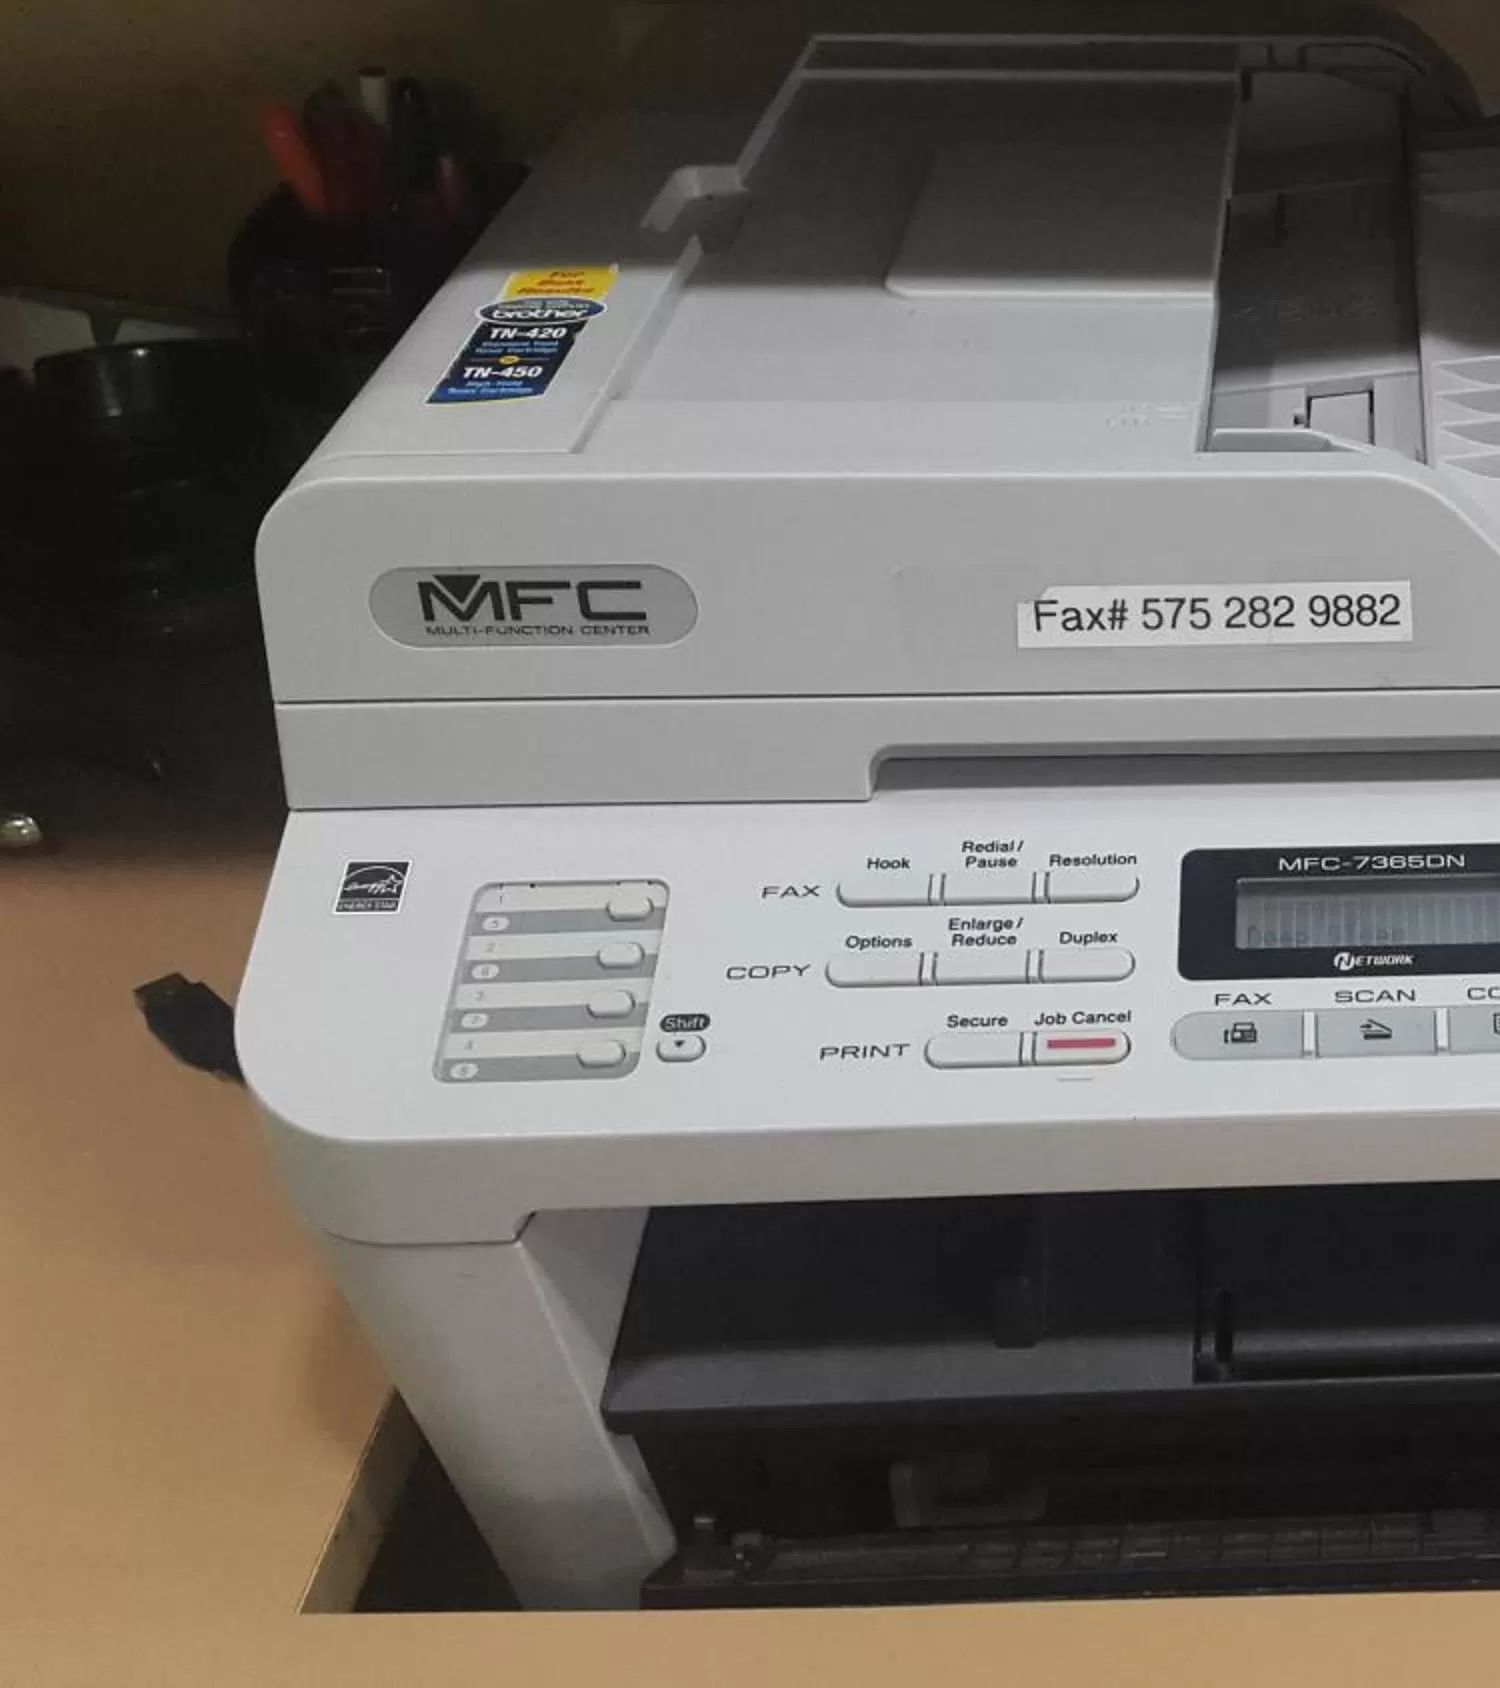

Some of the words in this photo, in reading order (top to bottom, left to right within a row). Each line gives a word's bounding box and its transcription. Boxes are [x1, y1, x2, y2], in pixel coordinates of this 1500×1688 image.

[492, 307, 587, 319] brother
[489, 327, 568, 339] TN-420
[462, 365, 544, 379] TN-450
[417, 575, 647, 621] MFC
[1032, 598, 1129, 632] Fax#
[1141, 596, 1212, 630] 575
[1223, 594, 1296, 629] 282
[1308, 593, 1402, 627] 9882
[425, 625, 573, 636] MULTI-FUNCTION
[580, 625, 650, 636] CENTER
[866, 857, 911, 871] Hook
[965, 855, 1018, 869] Pause
[1049, 853, 1138, 867] Resolution
[1278, 853, 1466, 872] MFC-7365DN
[761, 884, 821, 899] FAX
[845, 934, 913, 950] Options
[951, 933, 1017, 947] Reduce
[1059, 930, 1118, 946] Duplex
[726, 963, 811, 980] COPY
[1214, 992, 1273, 1007] FAX
[1334, 988, 1417, 1004] SCAN
[664, 1016, 706, 1031] Shift
[947, 1014, 1009, 1029] Secure
[1034, 1012, 1066, 1027] Job
[1071, 1010, 1132, 1026] Cancel
[819, 1043, 911, 1061] PRINT
